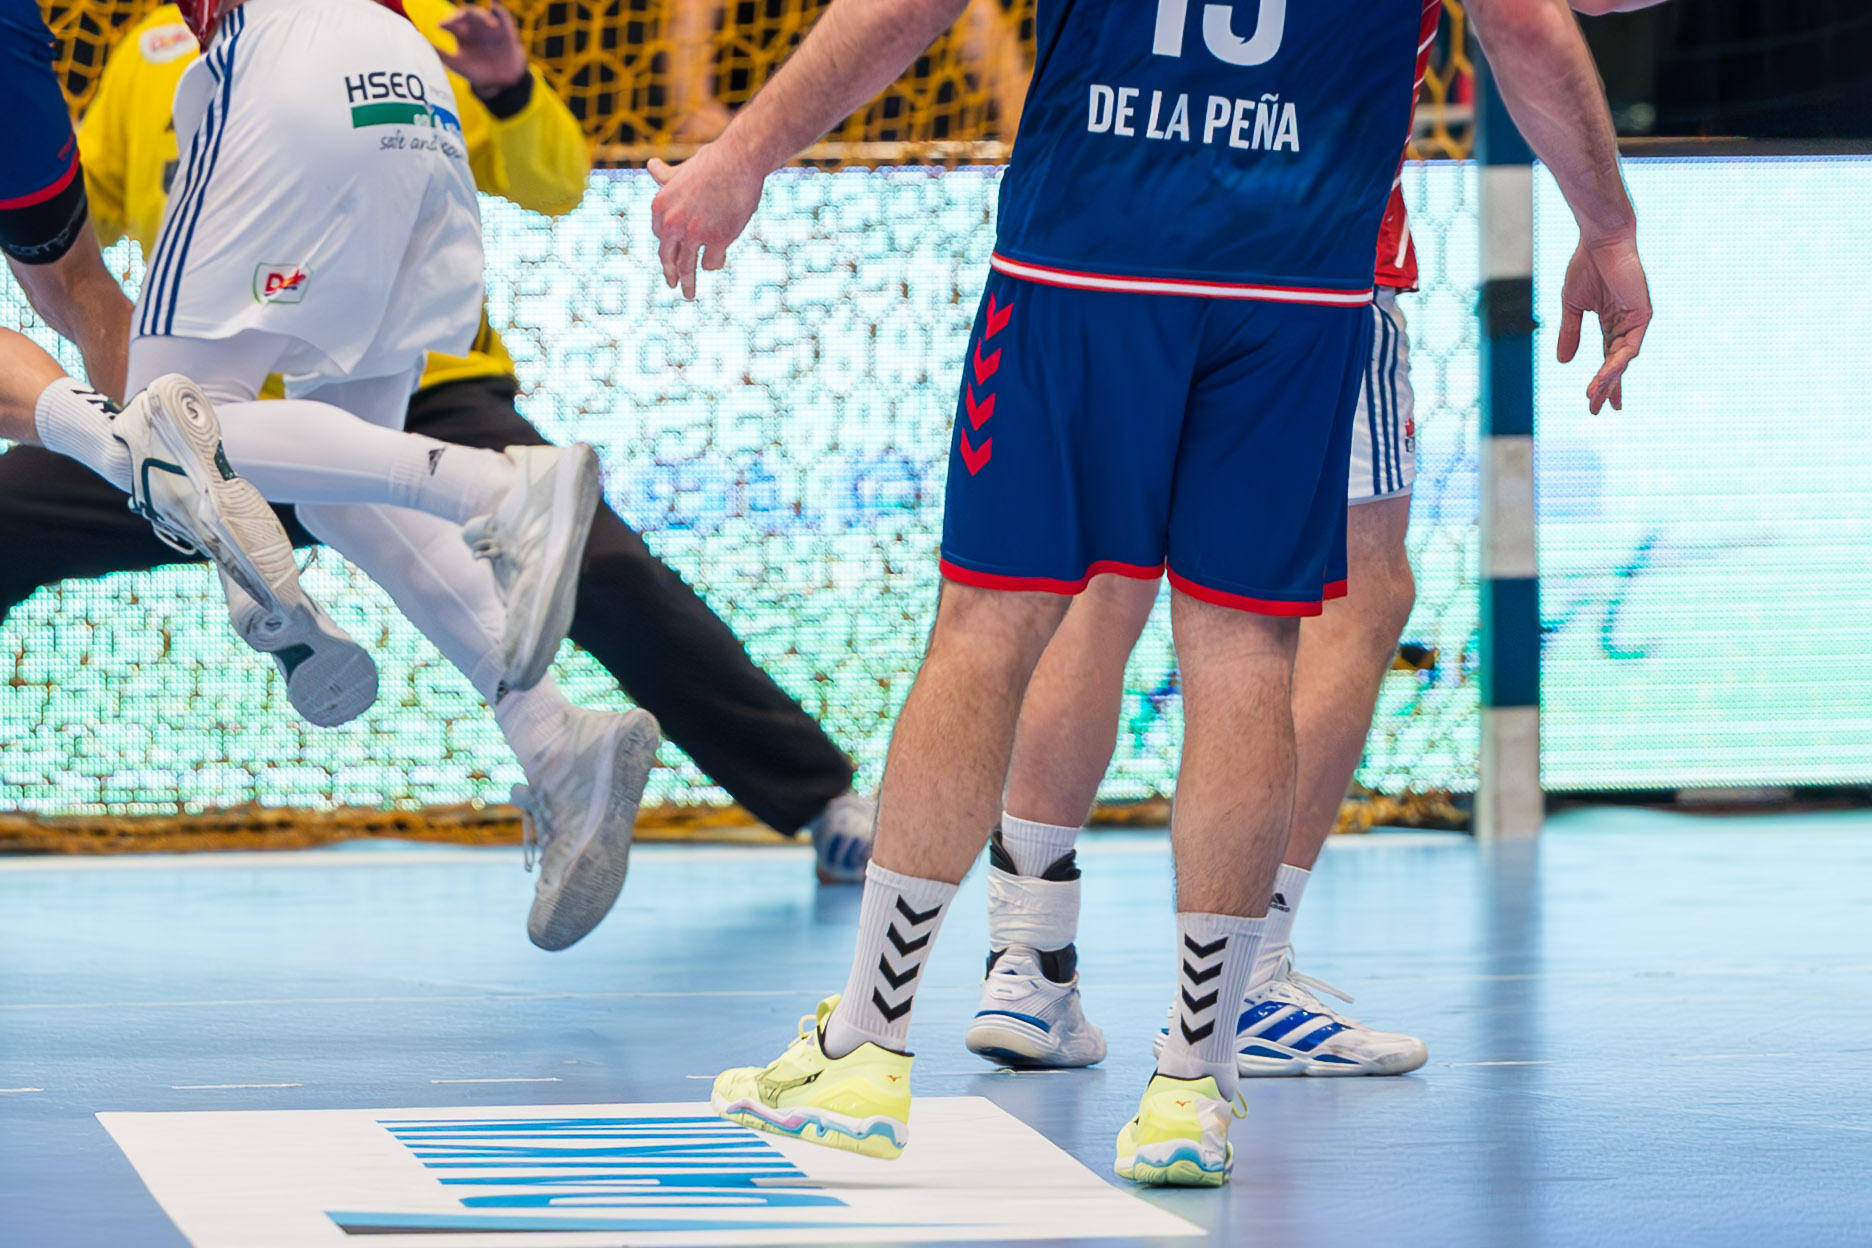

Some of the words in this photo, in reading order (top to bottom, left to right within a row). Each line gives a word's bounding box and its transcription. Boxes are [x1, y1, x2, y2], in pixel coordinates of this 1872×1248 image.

[345, 71, 429, 104] HSEQ
[1087, 84, 1140, 137] DE
[1146, 90, 1190, 142] LA
[1203, 93, 1300, 152] PEÑA
